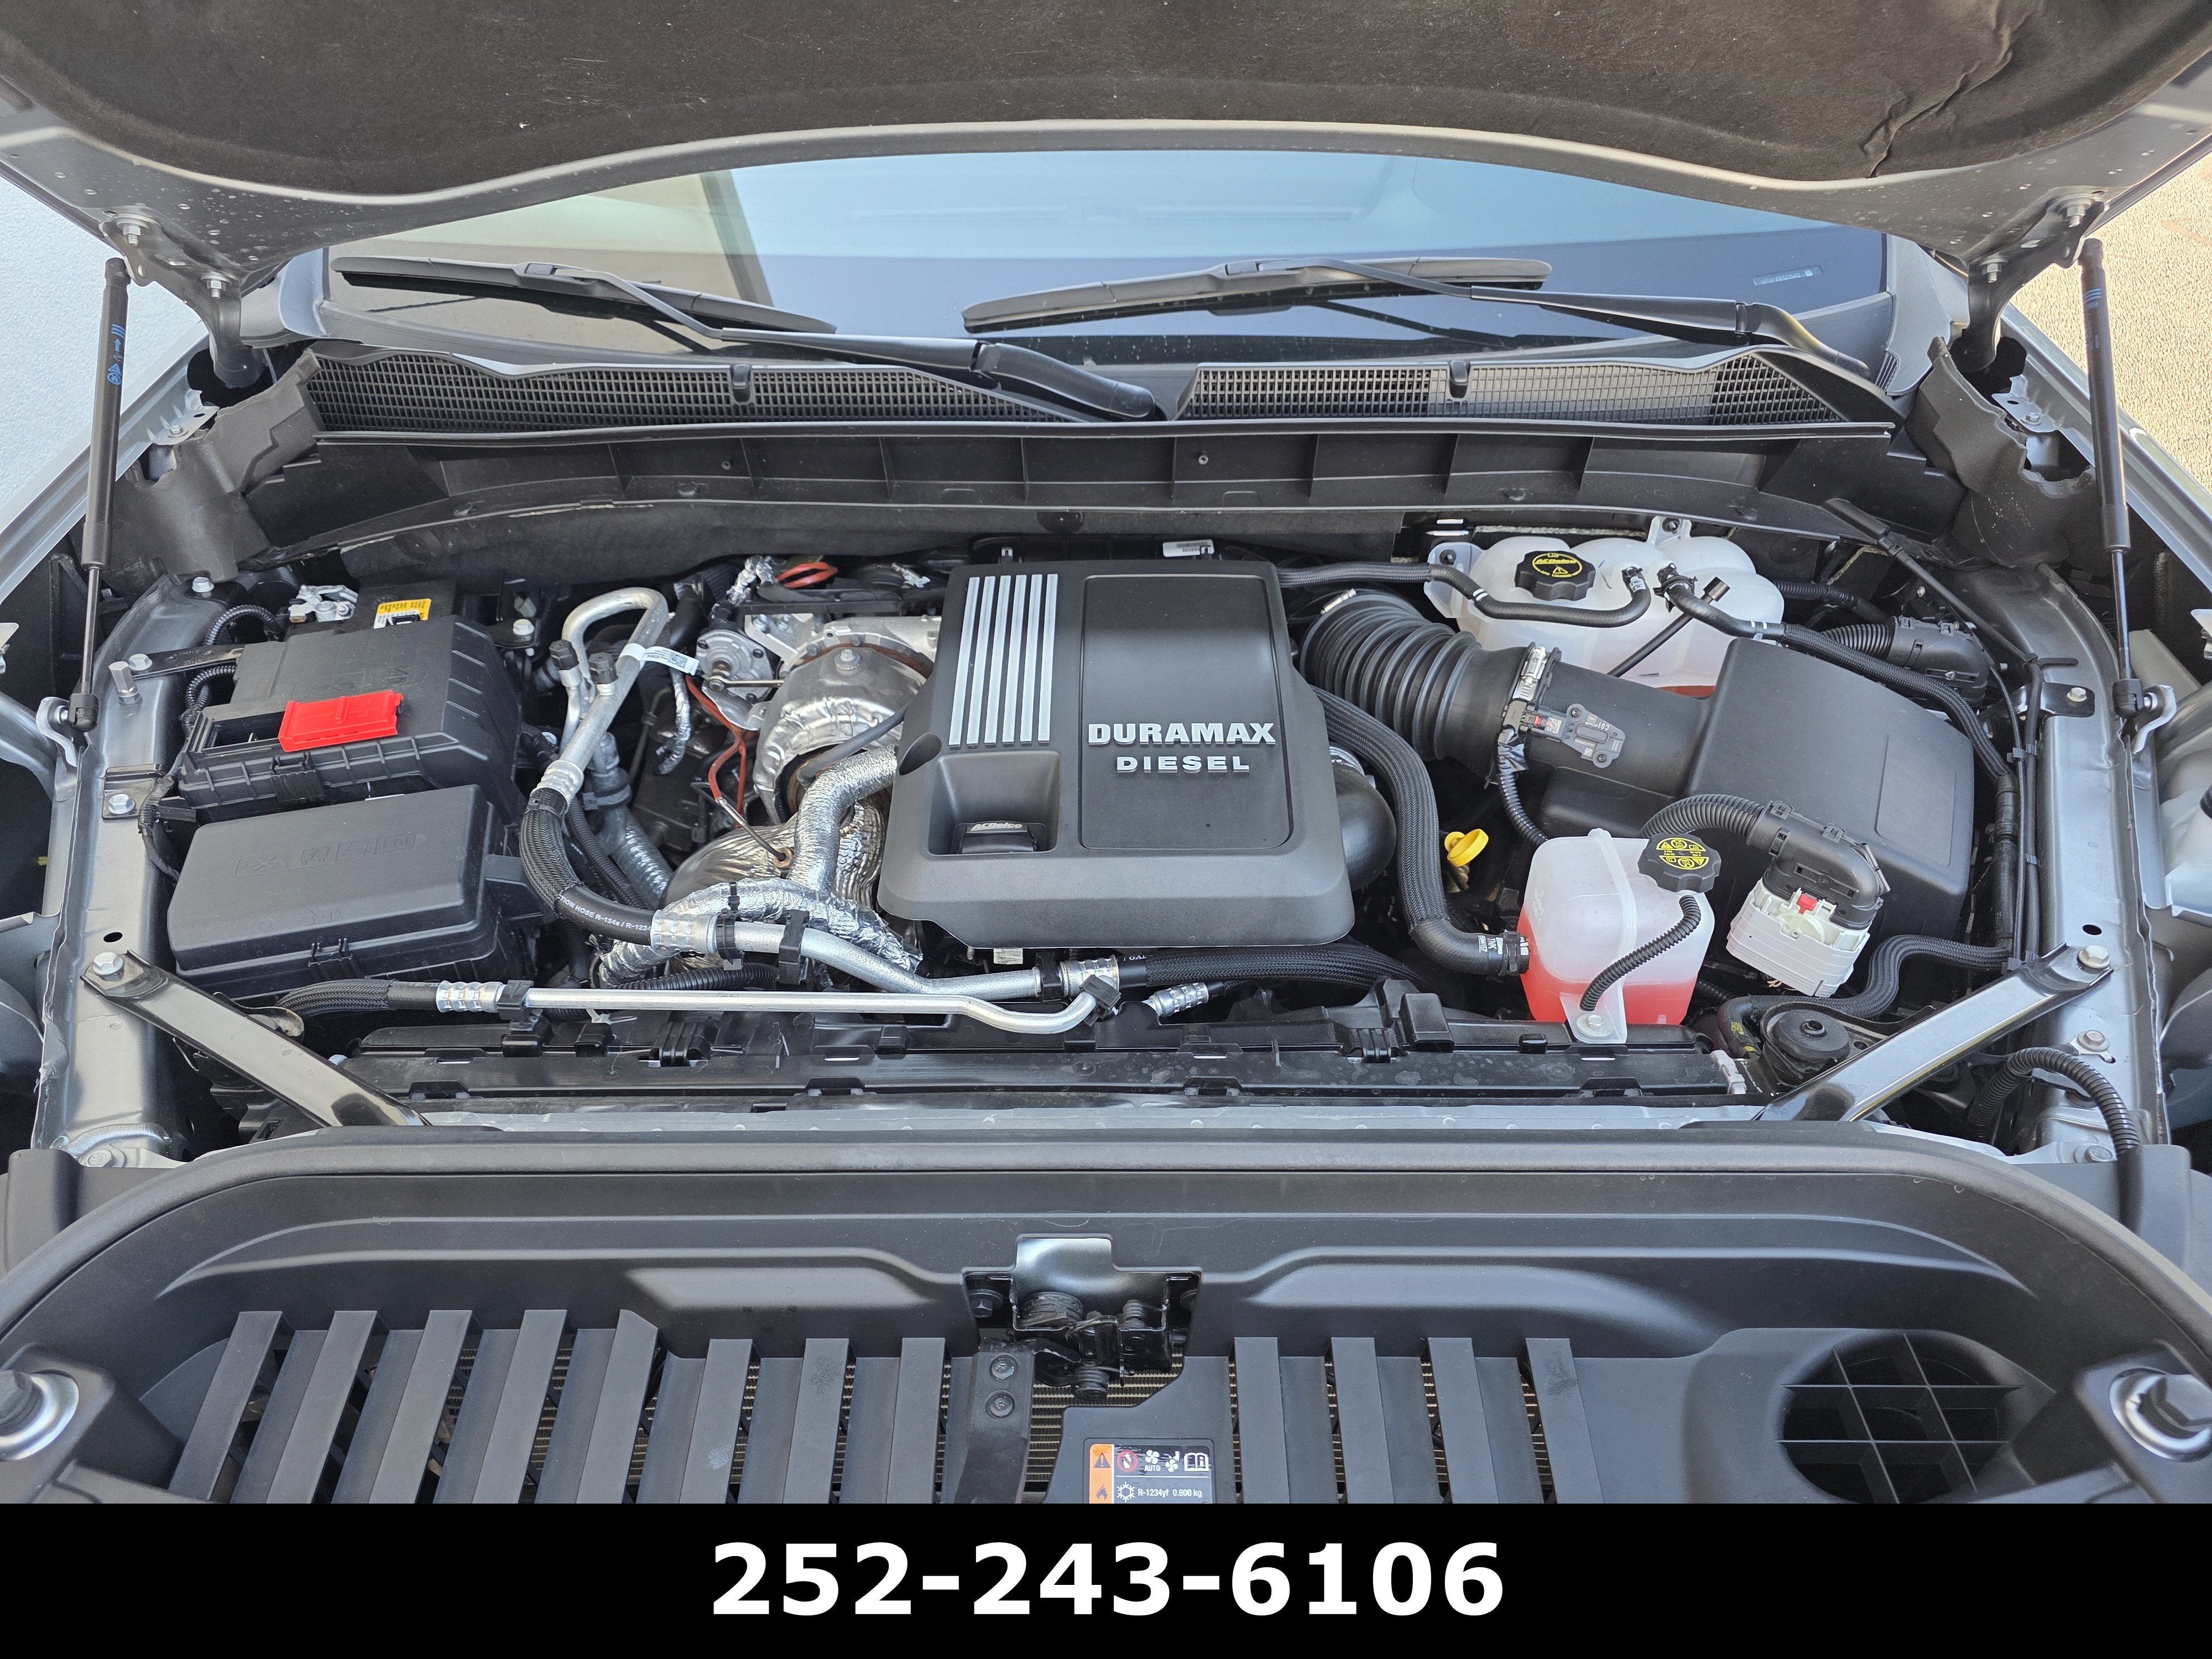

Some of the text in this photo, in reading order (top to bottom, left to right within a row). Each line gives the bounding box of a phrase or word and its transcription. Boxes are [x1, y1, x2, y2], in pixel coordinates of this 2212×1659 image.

[1088, 723, 1276, 745] DURAMAX
[1117, 755, 1250, 773] DIESEL
[971, 822, 1022, 831] ACDelco
[575, 905, 594, 918] HOSE
[594, 914, 620, 927] R-134a
[1138, 1489, 1202, 1498] R-1234yf 0.600 kg
